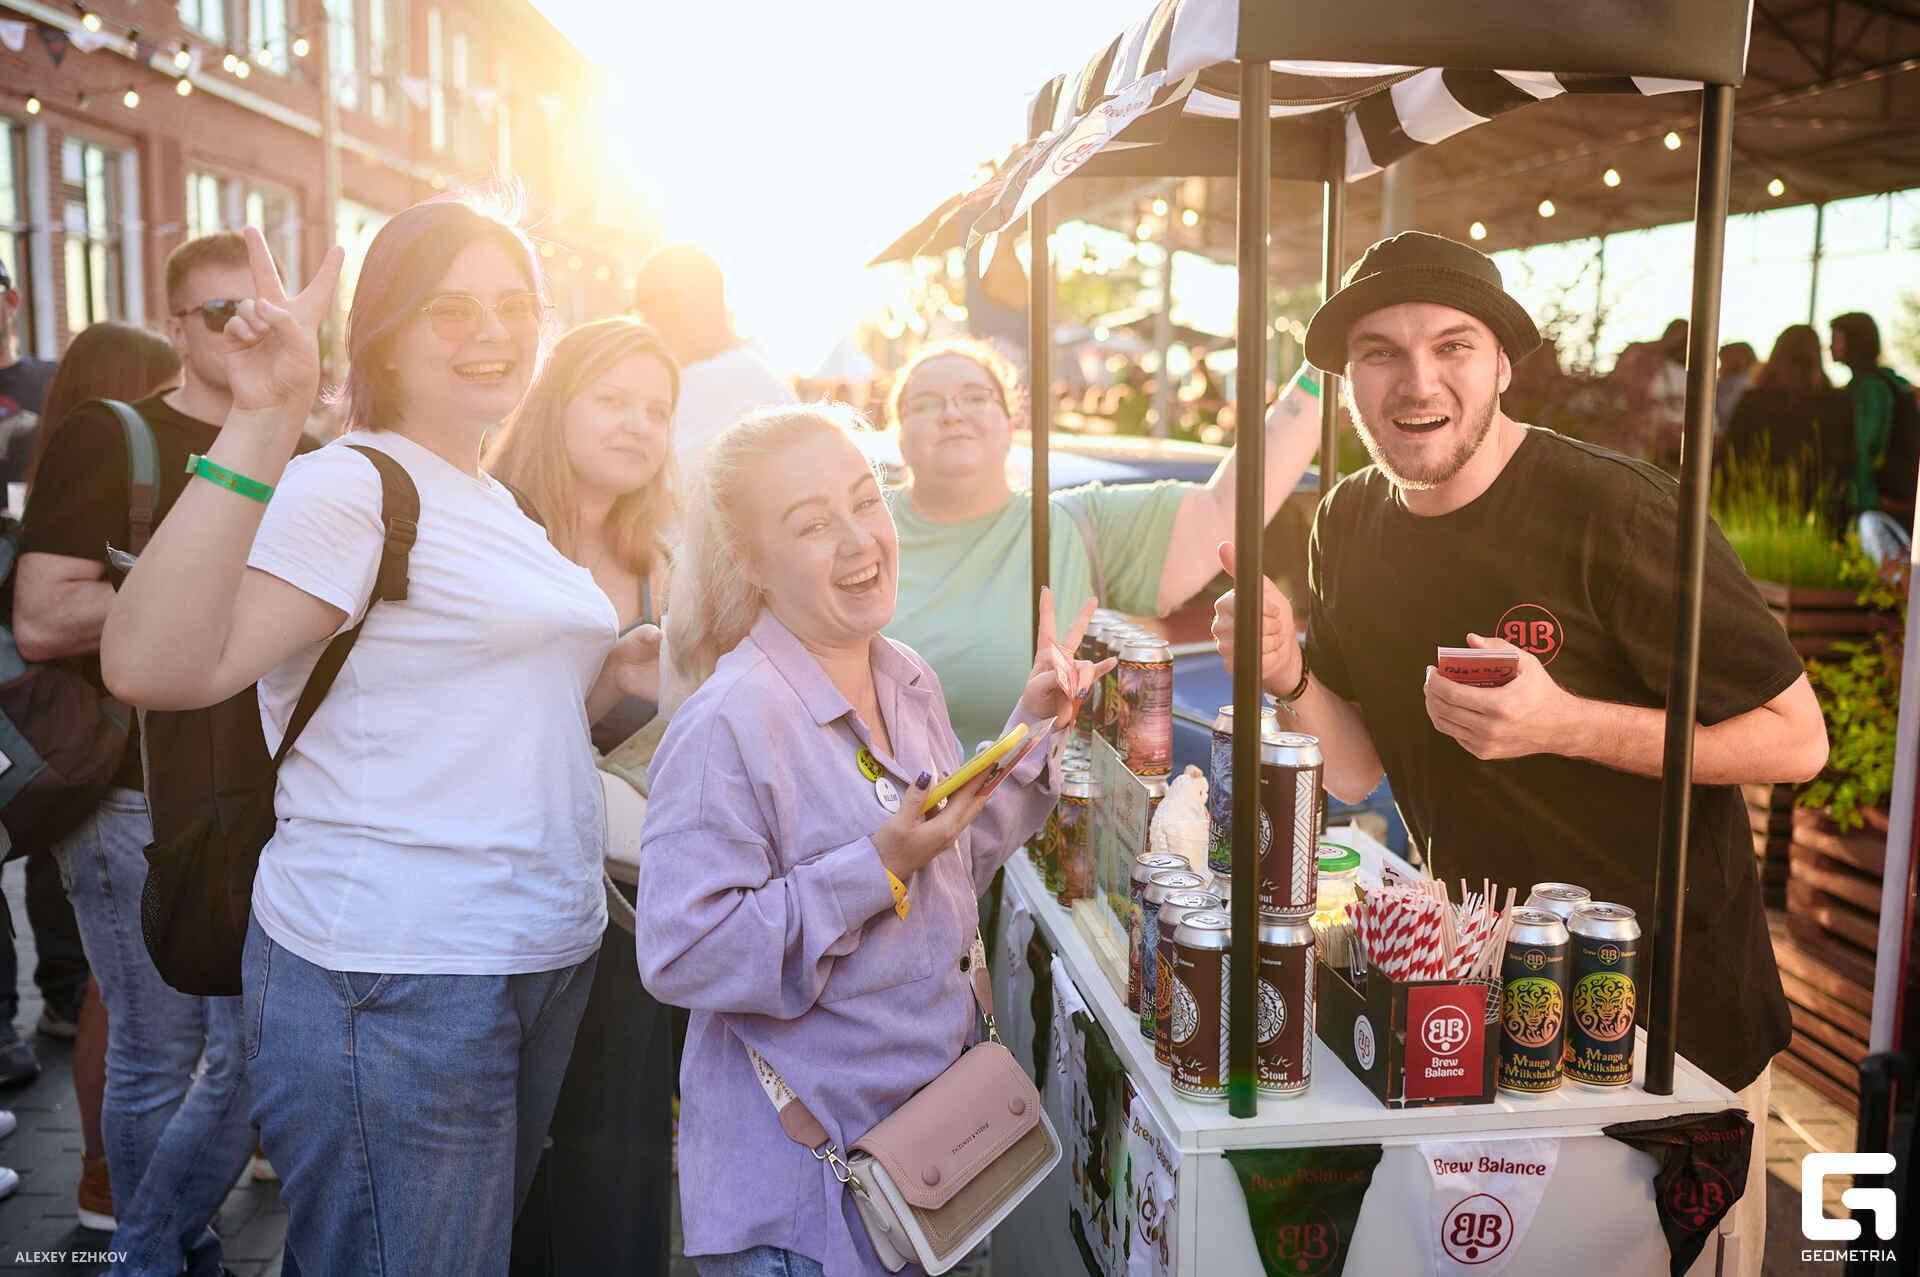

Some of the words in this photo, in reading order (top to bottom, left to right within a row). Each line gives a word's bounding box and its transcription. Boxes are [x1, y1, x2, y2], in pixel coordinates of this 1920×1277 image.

[1431, 1056, 1459, 1068] Brew
[1513, 1053, 1550, 1068] Mango
[1587, 1048, 1623, 1062] Mango
[1504, 1063, 1556, 1079] Milkshake
[1577, 1056, 1628, 1073] Milkshake
[1177, 1066, 1201, 1083] Stout
[1260, 1066, 1288, 1081] Stout
[1424, 1067, 1464, 1079] Balance
[1433, 1158, 1473, 1176] Brew
[1477, 1156, 1547, 1176] Balance
[1250, 1171, 1291, 1192] Brew
